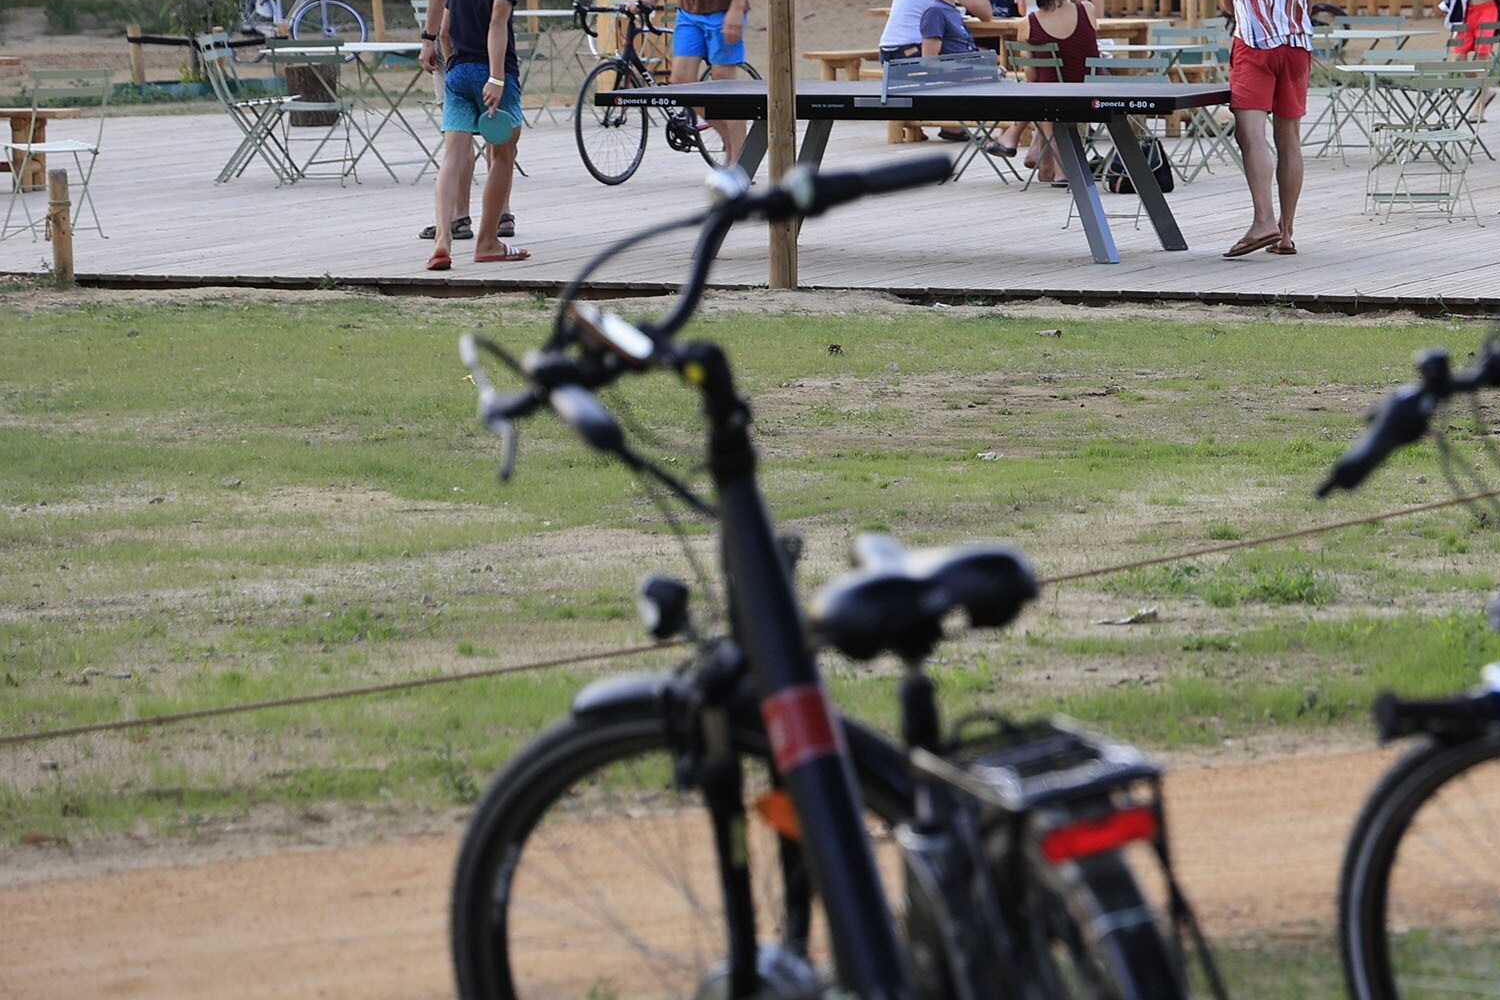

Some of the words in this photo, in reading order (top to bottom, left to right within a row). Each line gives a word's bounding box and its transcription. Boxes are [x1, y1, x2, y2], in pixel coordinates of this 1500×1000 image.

[617, 97, 647, 106] Sponeta
[651, 97, 670, 106] 6-80
[1095, 100, 1125, 109] Sponeta
[1129, 100, 1148, 109] 6-80
